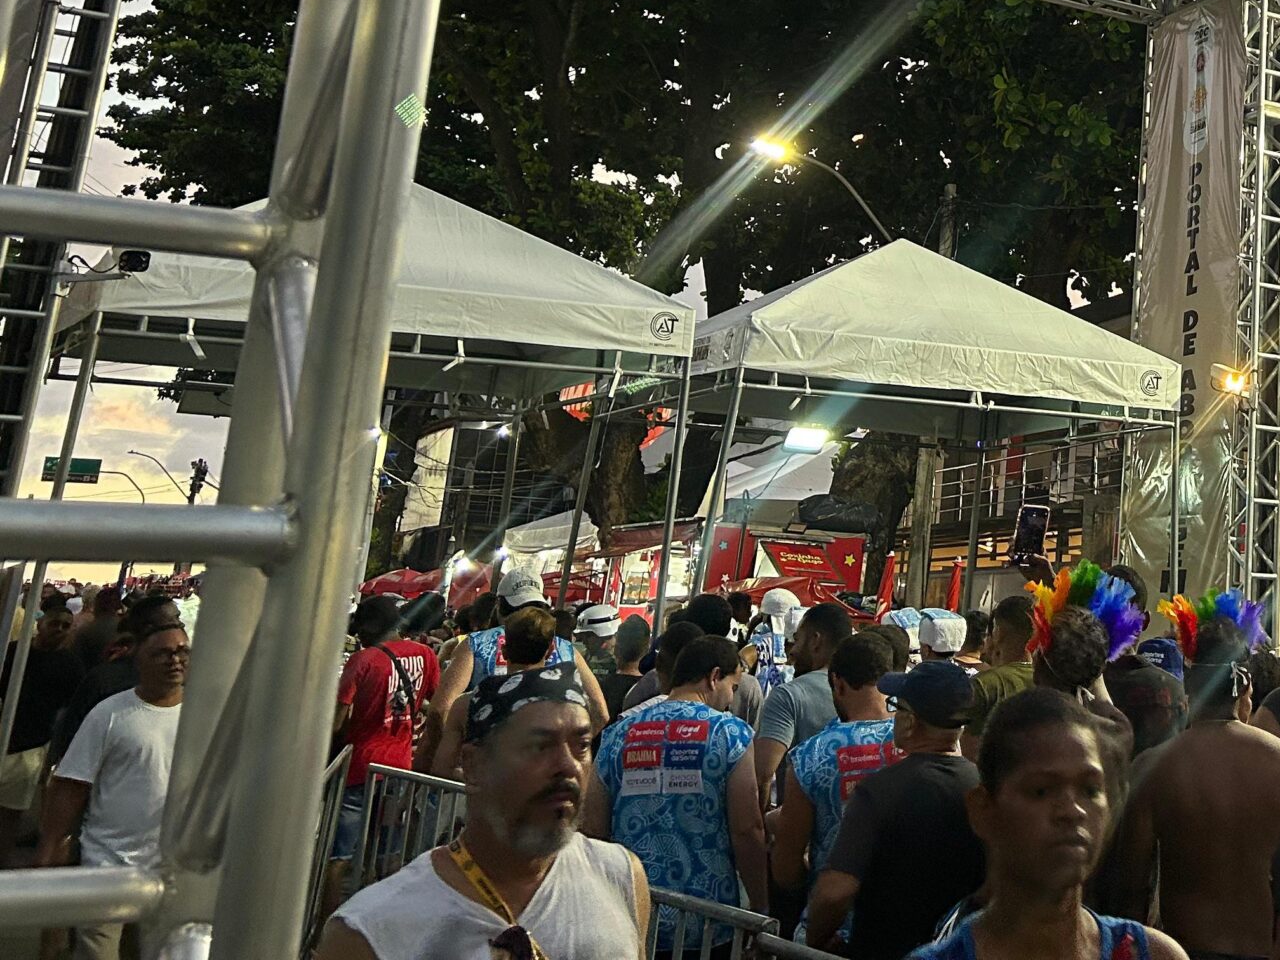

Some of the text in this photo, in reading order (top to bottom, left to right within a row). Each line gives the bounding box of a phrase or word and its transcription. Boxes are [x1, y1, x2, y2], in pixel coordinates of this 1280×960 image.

[1183, 161, 1202, 297] PORTAL
[1182, 309, 1199, 357] DE
[635, 728, 665, 737] bradesco
[626, 749, 657, 764] BRAHMA
